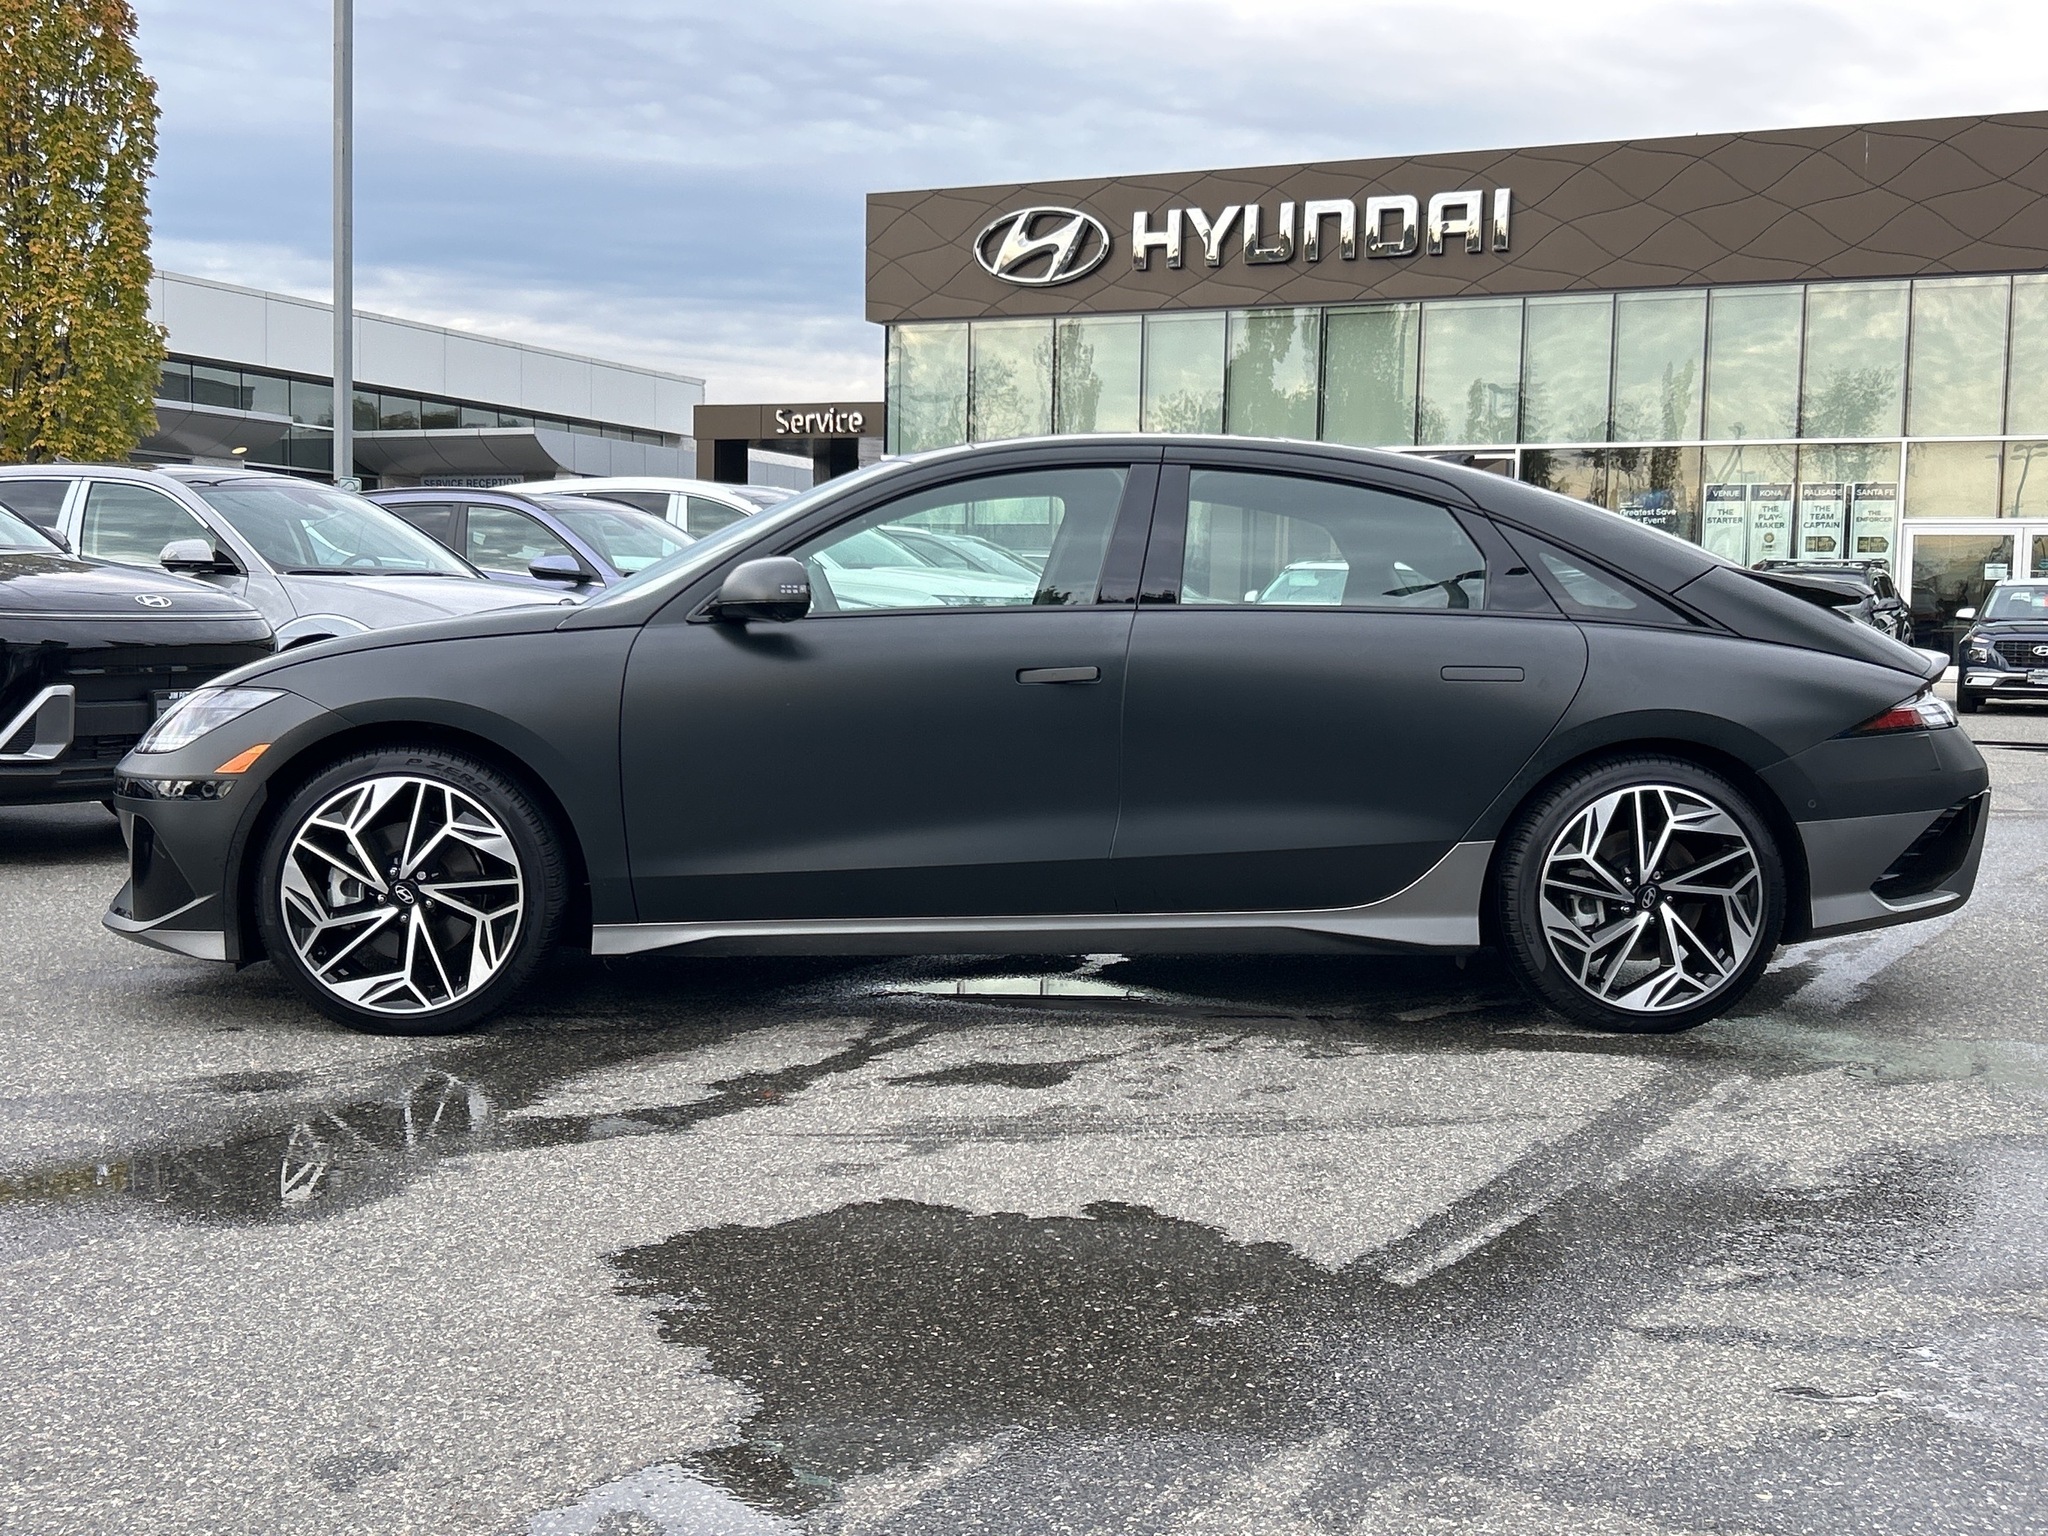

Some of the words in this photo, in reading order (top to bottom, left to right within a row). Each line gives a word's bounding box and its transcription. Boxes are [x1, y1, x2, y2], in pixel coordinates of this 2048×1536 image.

[1132, 188, 1512, 271] HYUNDAI
[775, 407, 864, 434] Service
[423, 479, 463, 488] SERVICE
[466, 478, 520, 489] RECEPTION
[1620, 508, 1655, 517] Greatest
[1655, 508, 1677, 516] Save
[1717, 508, 1734, 516] THE
[1762, 505, 1779, 513] THE
[1643, 517, 1666, 525] Event
